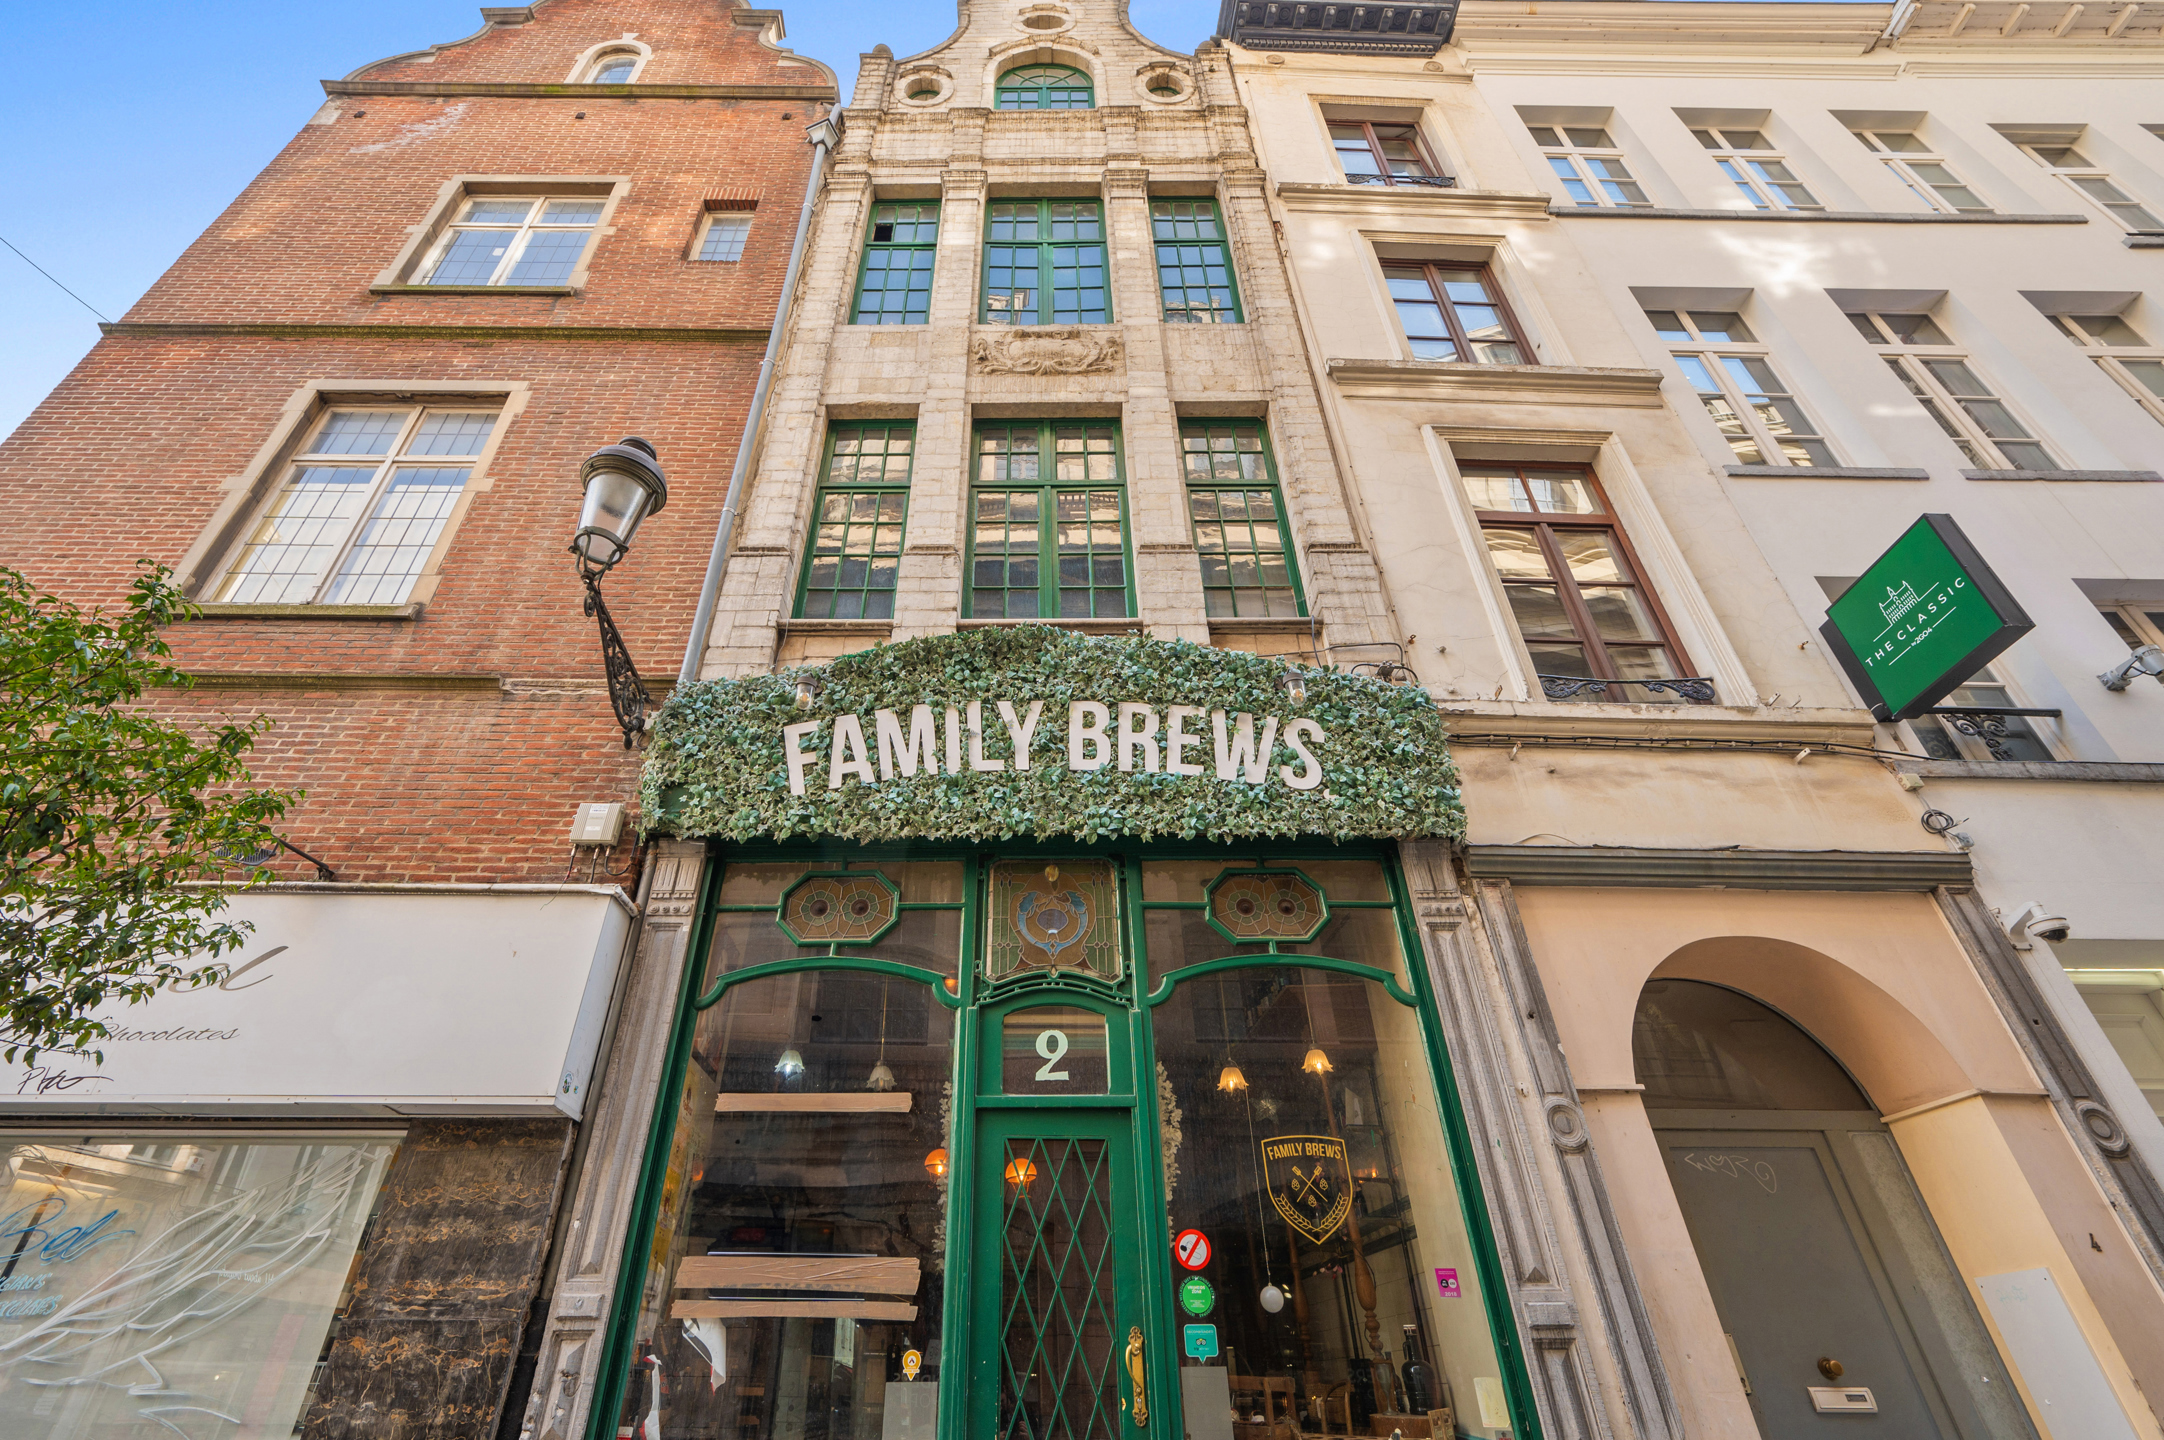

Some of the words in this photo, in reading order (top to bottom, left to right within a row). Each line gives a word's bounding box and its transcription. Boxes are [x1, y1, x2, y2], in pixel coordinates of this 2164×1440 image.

[1865, 641, 1895, 667] THE
[1897, 577, 1965, 640] CLASSIC
[1914, 627, 1933, 644] 2GO4
[784, 700, 1044, 796] FAMILY
[1035, 1029, 1070, 1082] 2
[1266, 1142, 1303, 1161] FAMILY
[1304, 1142, 1343, 1161] BREWS.
[2088, 1232, 2103, 1252] 4
